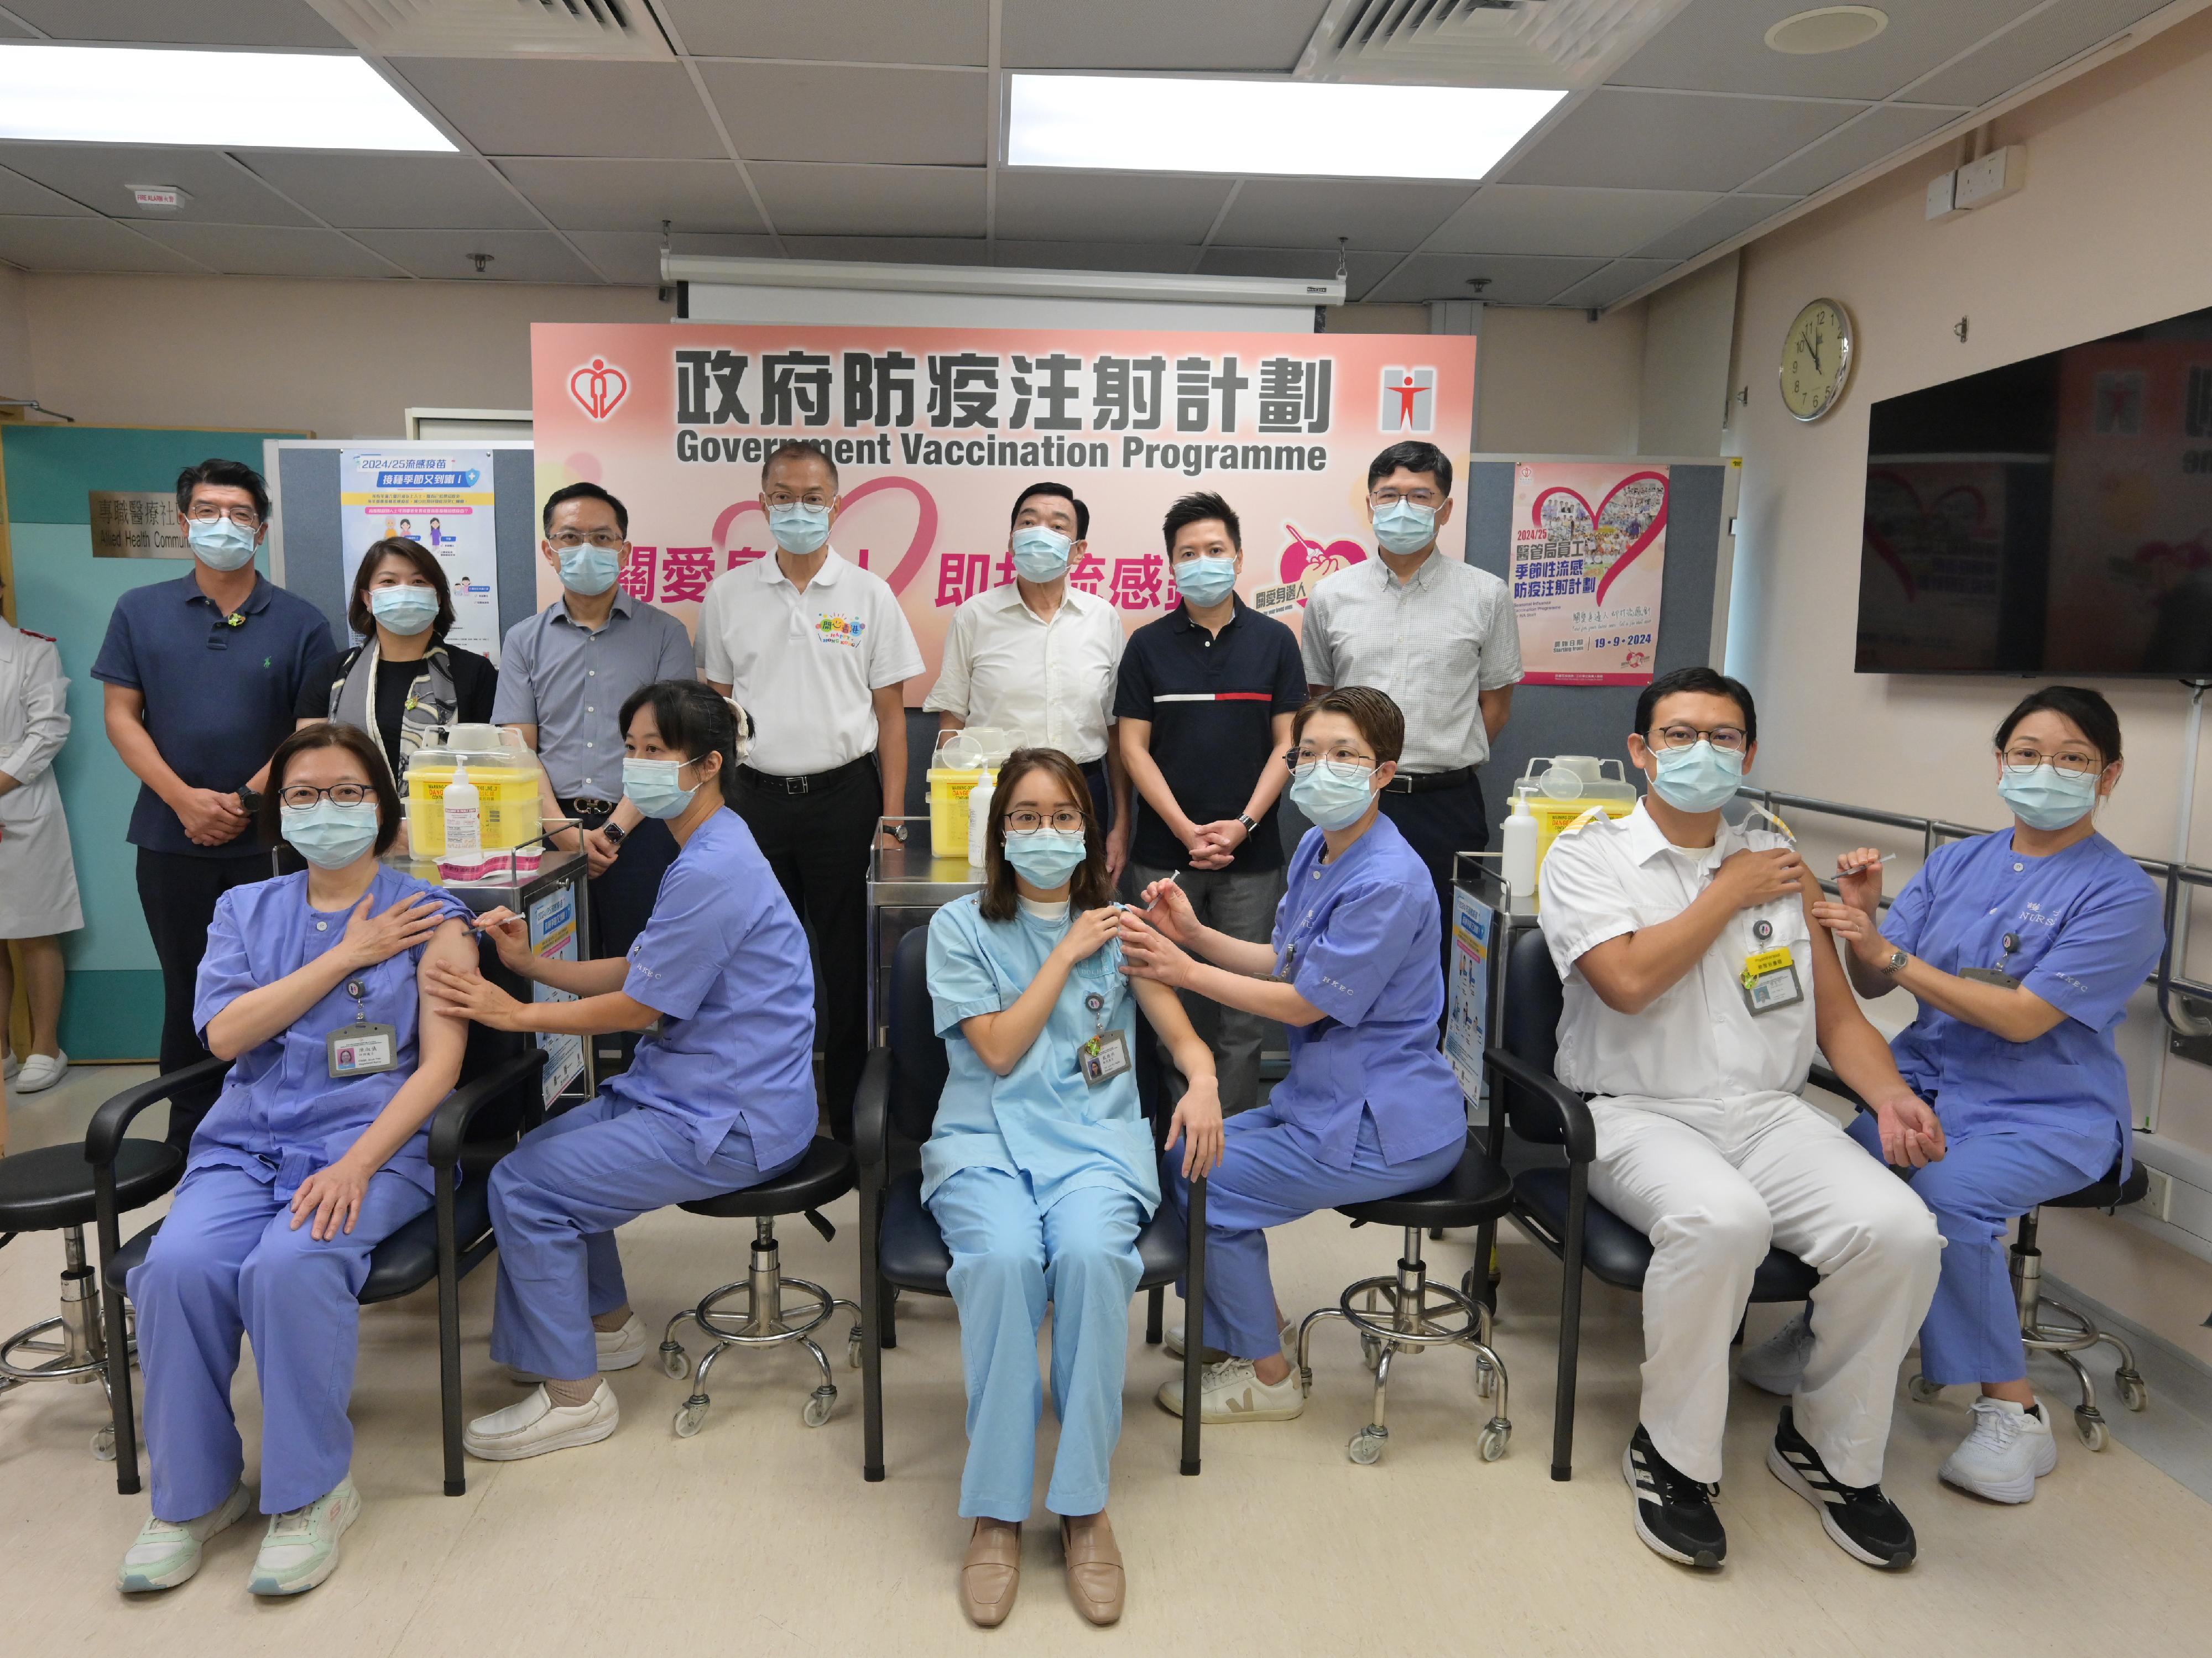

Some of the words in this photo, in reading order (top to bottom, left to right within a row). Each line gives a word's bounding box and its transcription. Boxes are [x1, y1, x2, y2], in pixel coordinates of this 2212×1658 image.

[1817, 311, 1824, 326] 12
[1805, 321, 1813, 334] 11
[1797, 340, 1804, 354] 10
[1793, 361, 1797, 374] 9
[675, 350, 1332, 433] 政府防疫注射計劃
[1794, 380, 1799, 393] 8
[1802, 393, 1807, 405] 7
[1813, 395, 1818, 408] 6
[677, 430, 890, 464] Goverent
[901, 433, 1108, 467] Vaccination
[1123, 436, 1327, 476] Programme
[362, 459, 446, 469] 2024/25流感疫苗
[98, 500, 181, 526] 專職醫療社
[101, 530, 121, 546] Allied
[125, 531, 150, 547] Health
[1517, 529, 1547, 540] 2024/25
[1517, 541, 1584, 561] 醫管局員工
[1515, 559, 1583, 579] 季節性流感
[1256, 582, 1306, 609] 關愛身邊人
[1514, 577, 1596, 599] 防疫注射計劃
[637, 963, 661, 980] HKEC
[1322, 976, 1354, 996] HKEC
[2056, 972, 2088, 992] HKEC
